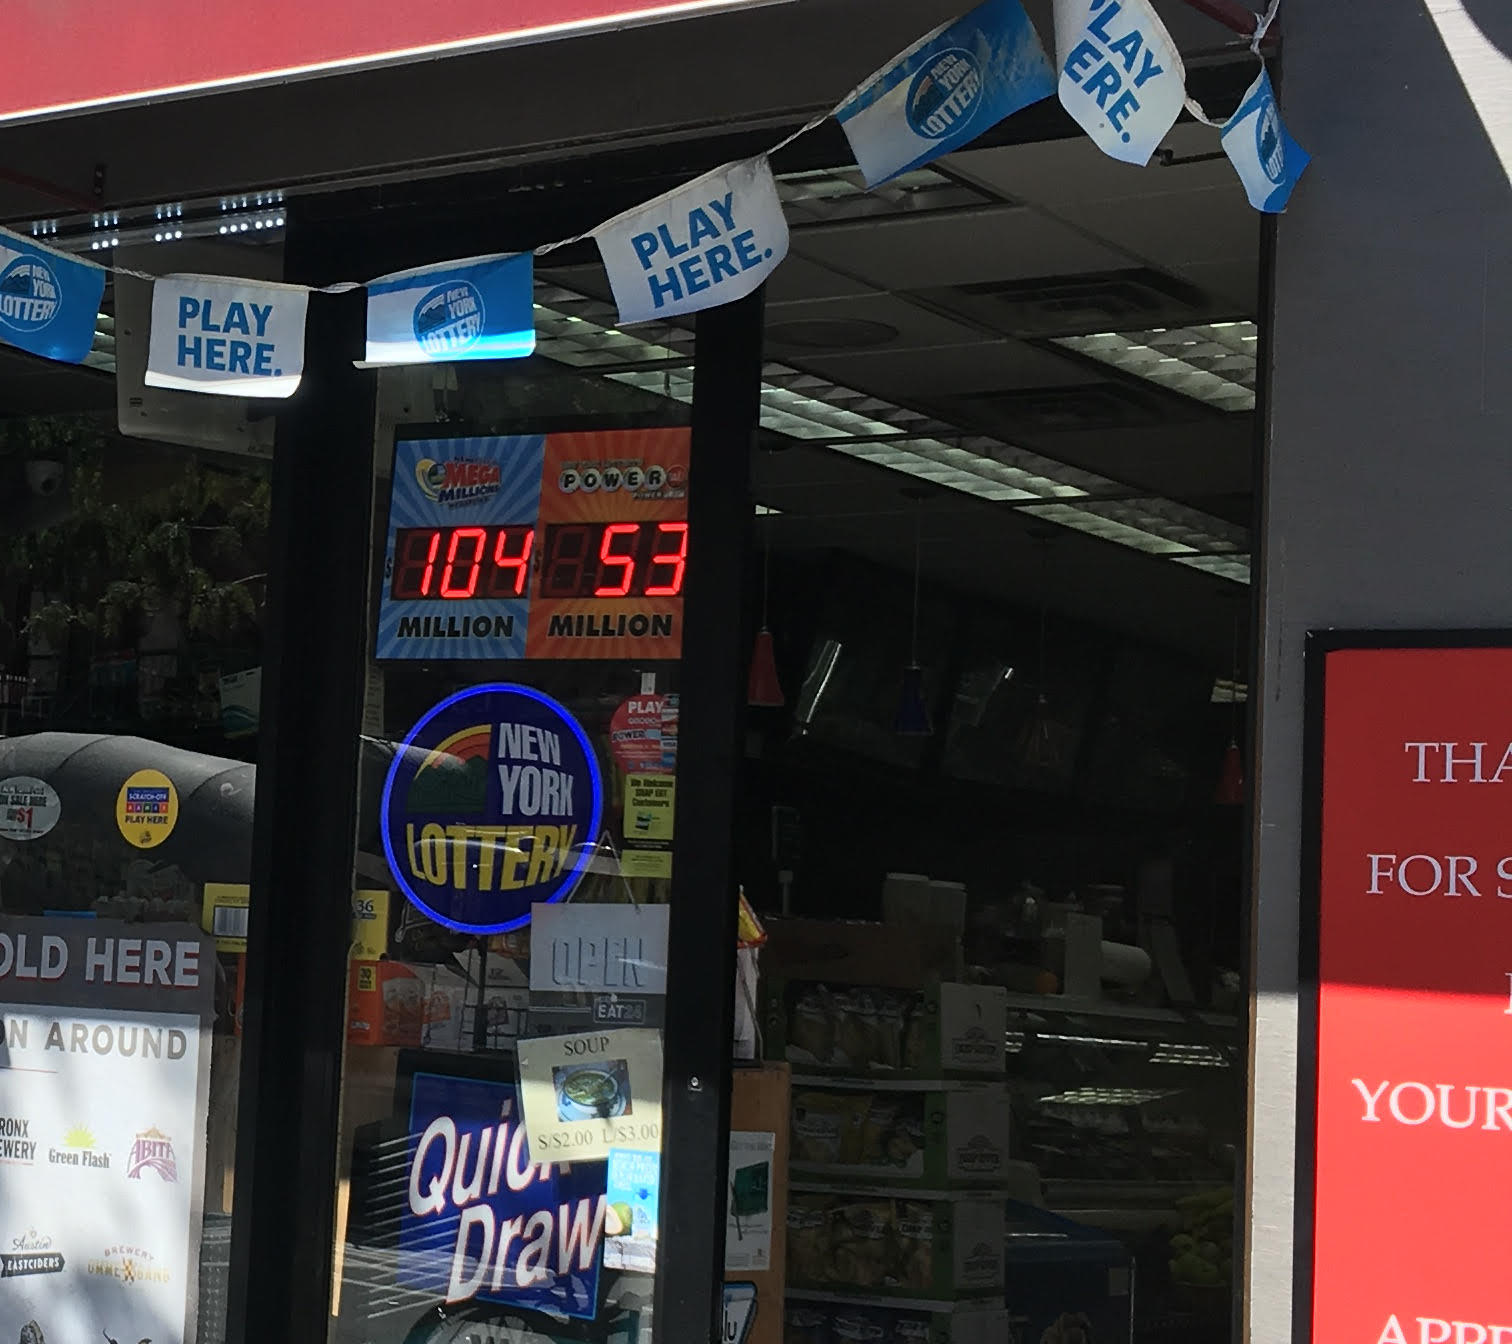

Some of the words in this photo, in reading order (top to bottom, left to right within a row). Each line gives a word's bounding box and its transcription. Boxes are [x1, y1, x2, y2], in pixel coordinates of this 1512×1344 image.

[938, 57, 974, 92] YORK
[1063, 39, 1142, 144] ERE.
[920, 70, 981, 137] LOTTERY
[630, 191, 739, 272] PLAY
[32, 264, 50, 282] NEW
[646, 228, 774, 311] HERE.
[177, 296, 274, 338] PLAY
[446, 286, 468, 304] NEW
[448, 296, 478, 320] YORK
[419, 311, 481, 355] LOTTERY
[176, 333, 284, 378] HERE.
[419, 527, 535, 598] 104
[593, 522, 688, 597] 53
[397, 615, 514, 638] MILLION
[548, 614, 673, 637] MILLION
[627, 700, 664, 714] PLAY
[497, 721, 561, 767] NEW
[496, 763, 575, 819] YORK
[124, 815, 145, 825] PLAY
[146, 815, 169, 825] HERE
[405, 821, 577, 893] LOTTERY
[1365, 853, 1481, 898] FOR
[84, 938, 202, 988] HERE
[551, 935, 646, 987] OPEN
[44, 1021, 189, 1061] AROUND
[563, 1035, 611, 1057] SOUP
[1350, 1078, 1512, 1134] YOUR
[48, 1148, 80, 1167] Green
[80, 1150, 111, 1170] Flash
[128, 1137, 176, 1163] ABITA
[6, 1255, 61, 1272] EASTCIDERS
[443, 1194, 609, 1307] Draw
